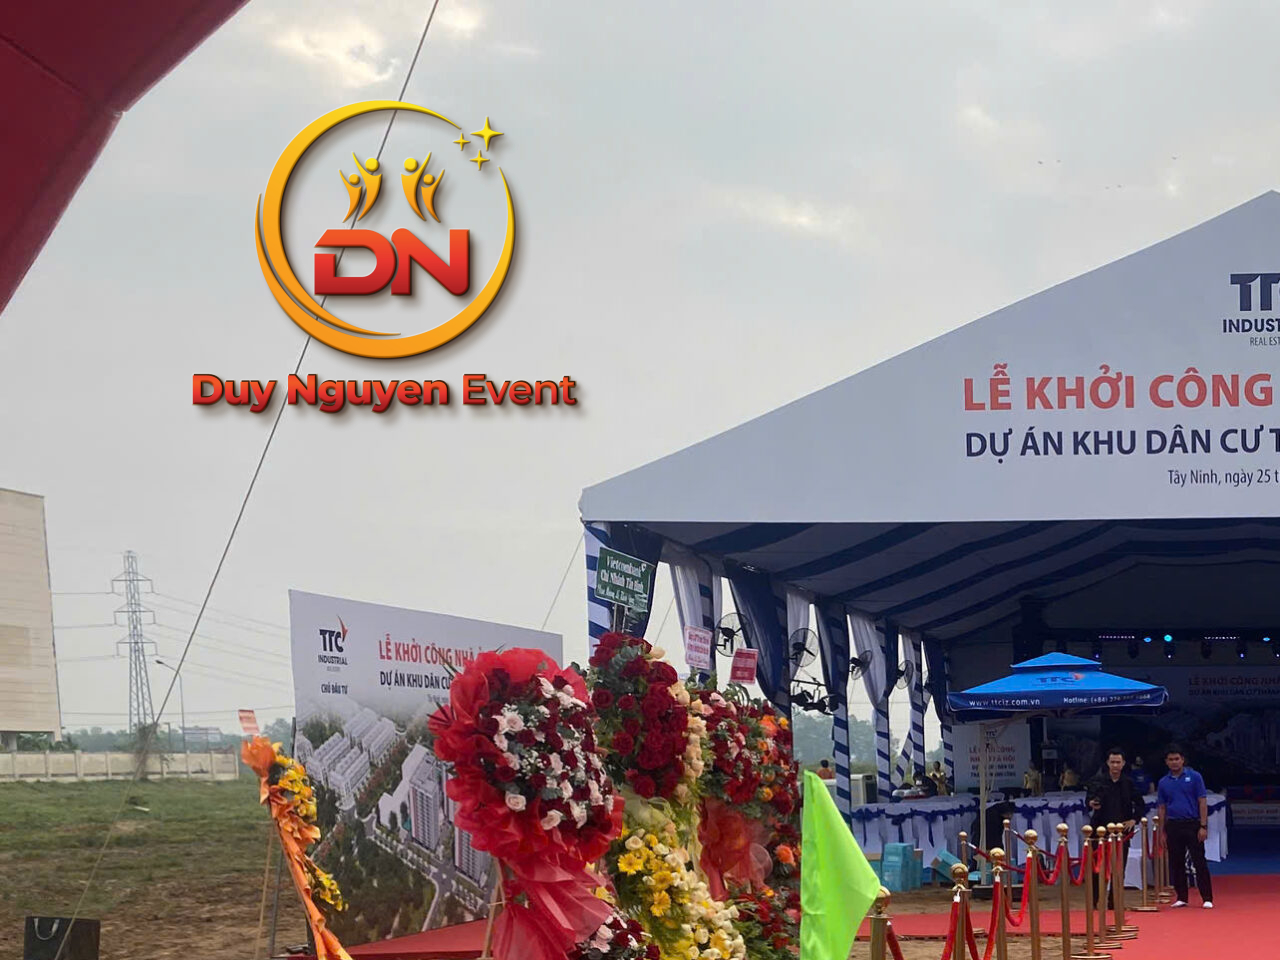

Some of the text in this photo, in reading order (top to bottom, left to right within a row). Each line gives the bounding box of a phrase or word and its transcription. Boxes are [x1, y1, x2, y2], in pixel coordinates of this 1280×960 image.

[1249, 337, 1267, 346] REAL
[964, 363, 1012, 411] LỄ
[1026, 364, 1135, 410] KHỞI
[1149, 367, 1273, 408] CÔNG
[966, 427, 1013, 464] DỰ
[1020, 425, 1063, 456] ÁN
[1073, 430, 1136, 456] KHU
[1146, 424, 1211, 455] DÂN
[1220, 424, 1264, 453] CƯ
[1168, 469, 1187, 488] Tây
[1190, 470, 1221, 486] Ninh,
[1225, 470, 1253, 487] ngày
[1256, 469, 1270, 484] 25
[319, 629, 344, 653] TTC
[395, 638, 422, 663] KHỞI
[407, 673, 423, 688] KHU
